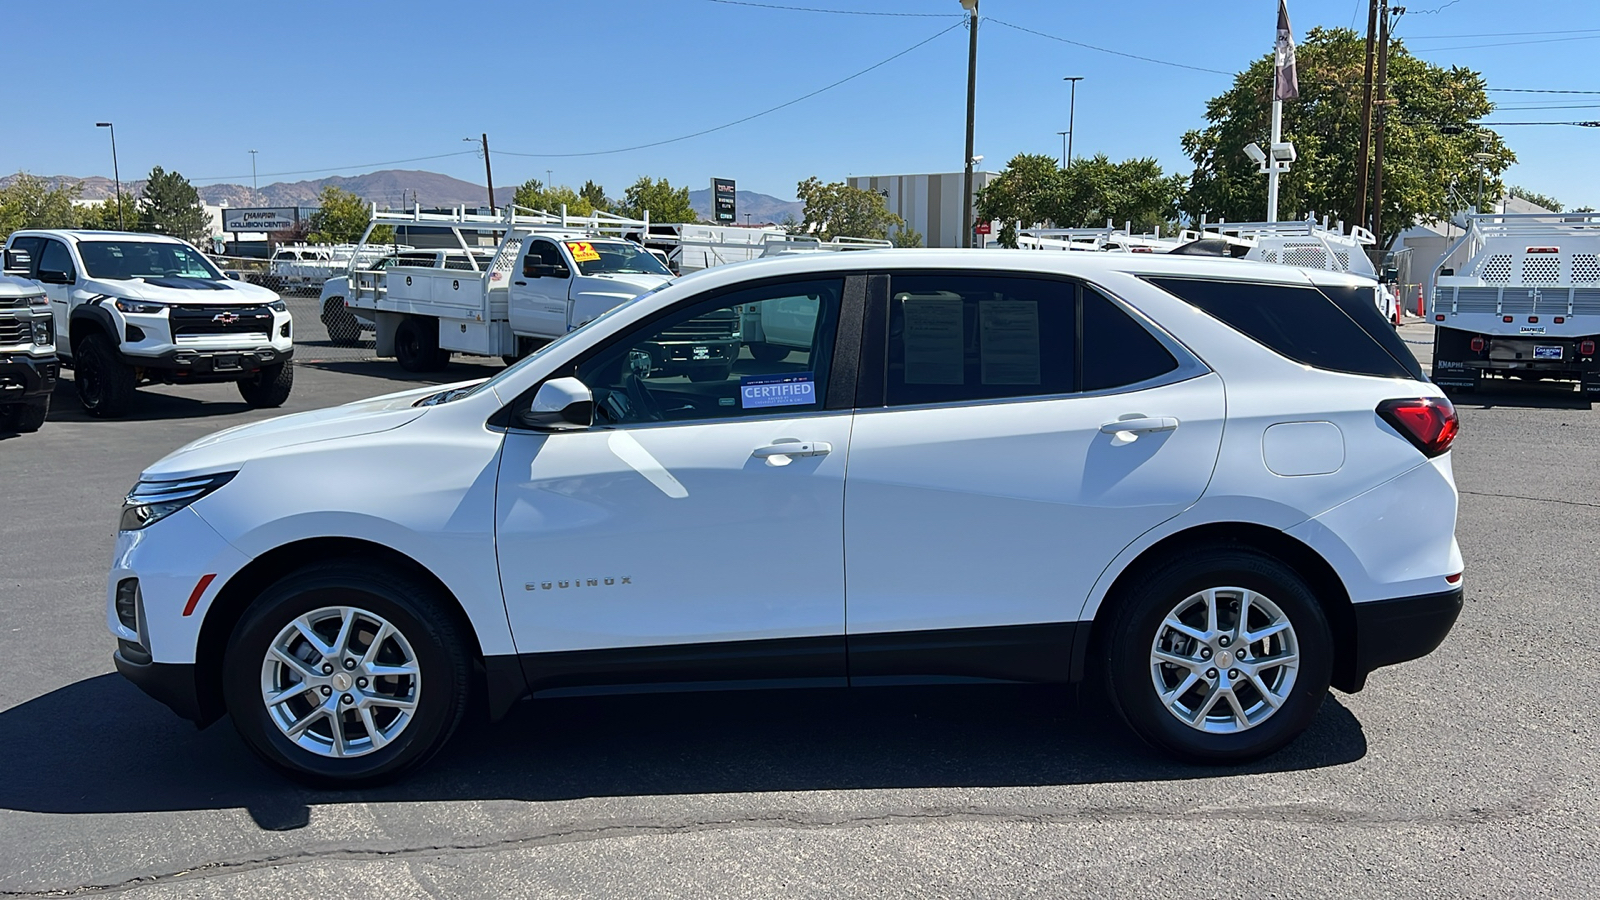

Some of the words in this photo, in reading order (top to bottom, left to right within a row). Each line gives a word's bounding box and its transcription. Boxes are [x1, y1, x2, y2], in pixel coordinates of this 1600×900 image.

[244, 213, 276, 221] CHAMPION
[568, 242, 597, 254] 22
[744, 384, 811, 398] CERTIFIED
[525, 576, 632, 591] EQUINOX
